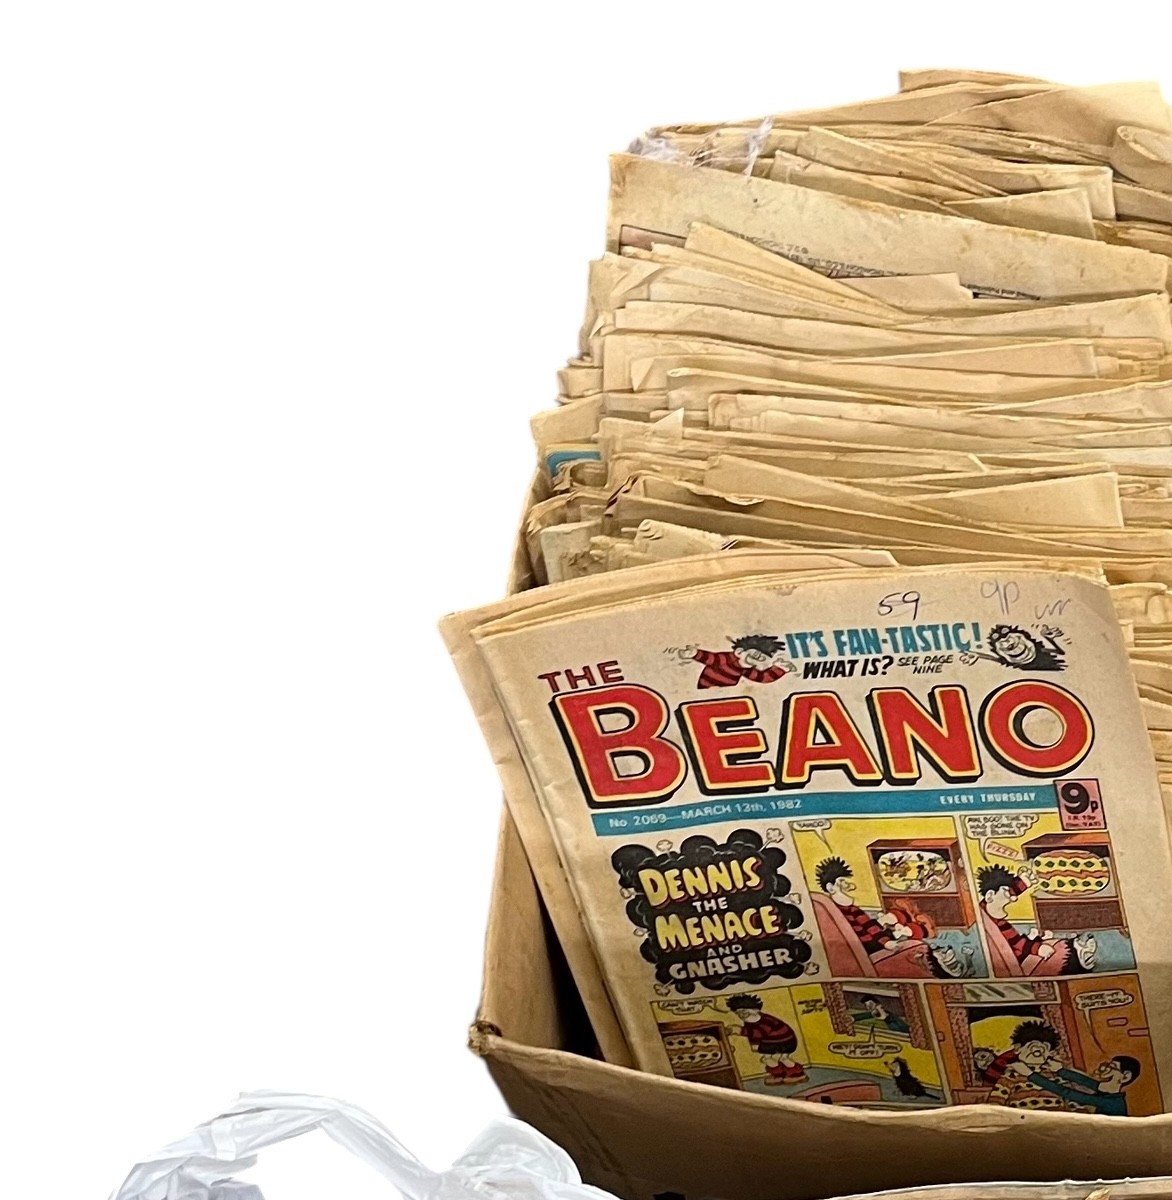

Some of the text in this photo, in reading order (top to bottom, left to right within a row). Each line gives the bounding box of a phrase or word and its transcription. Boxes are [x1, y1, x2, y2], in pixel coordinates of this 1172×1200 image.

[876, 590, 922, 621] 59
[785, 622, 982, 658] IT'S FAN-TASTIC!
[802, 655, 894, 680] WHAT IS?
[897, 654, 954, 667] SEE PAGE
[912, 663, 944, 675] NINE
[537, 660, 625, 693] THE
[548, 678, 1096, 809] BEANO
[770, 798, 802, 810] 1982
[940, 792, 1036, 805] EVERY THURSDAY
[637, 856, 763, 907] DENNIS
[692, 896, 729, 913] THE
[654, 904, 782, 951] MENACE
[668, 947, 794, 981] GNASHER
[706, 943, 743, 958] AND
